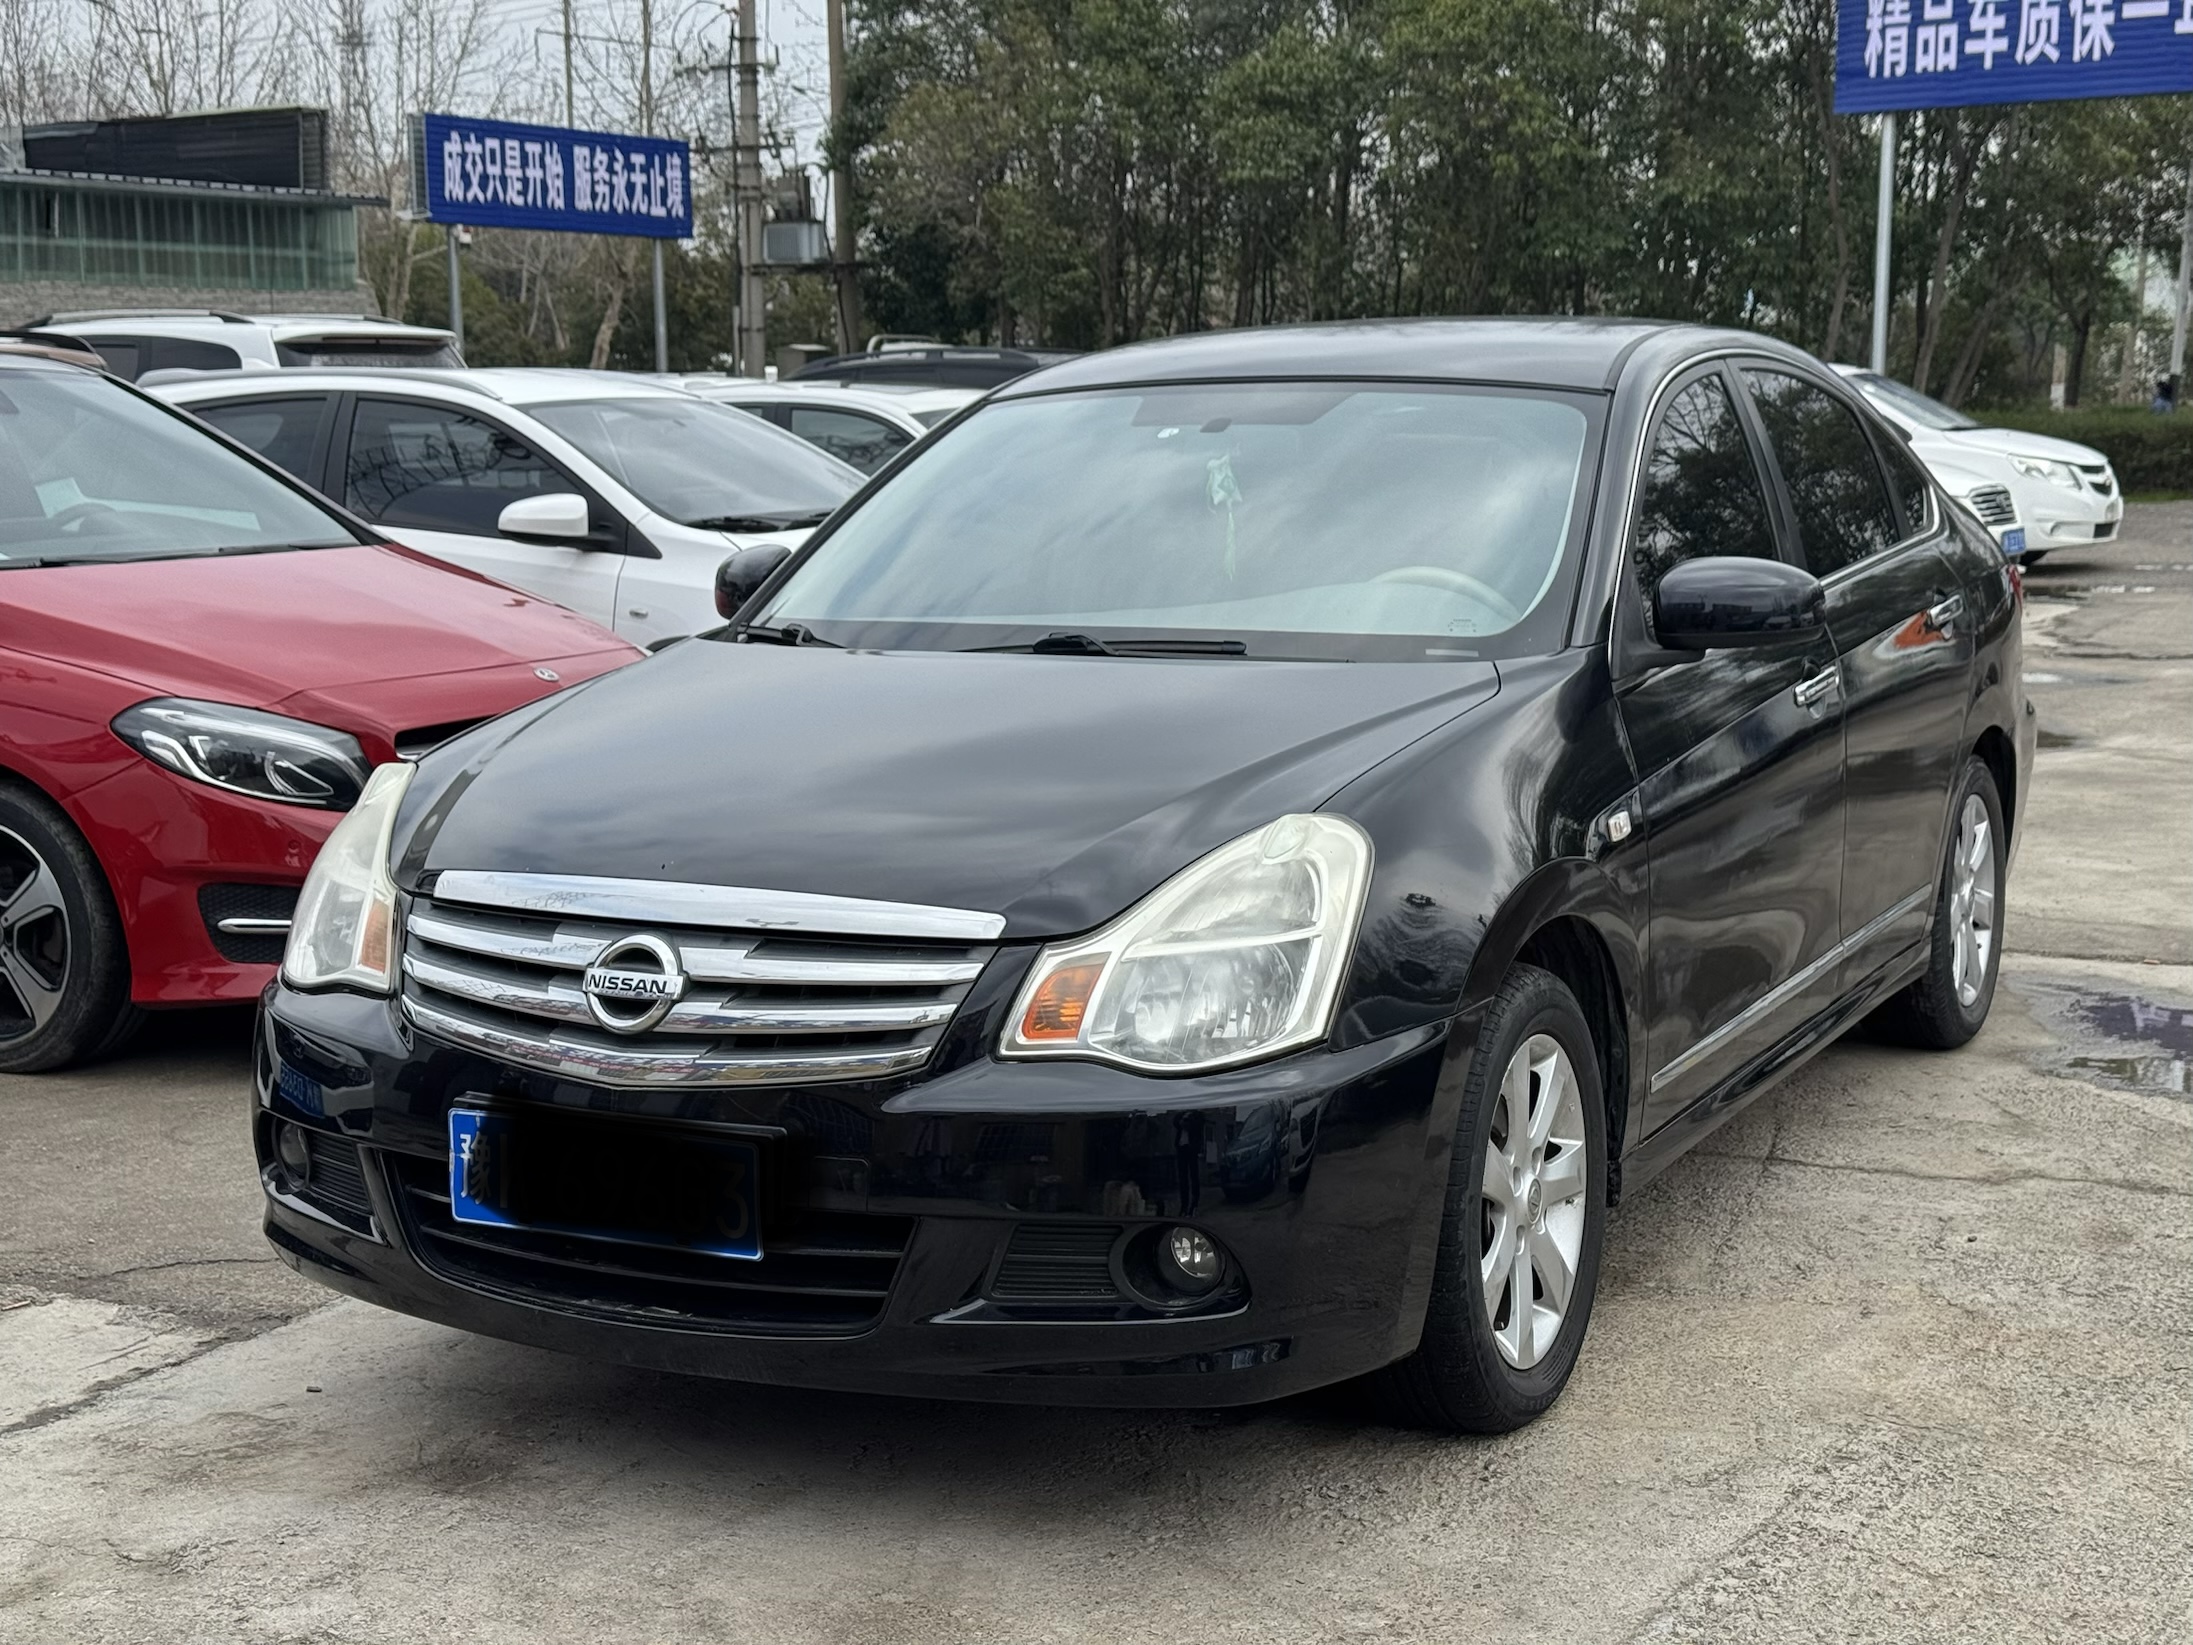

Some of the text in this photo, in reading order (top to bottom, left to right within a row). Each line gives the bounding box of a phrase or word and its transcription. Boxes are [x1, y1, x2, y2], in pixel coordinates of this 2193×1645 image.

[1863, 0, 2193, 78] 精品车质保一
[443, 130, 685, 218] 成交只是开始 服务永无止境
[588, 974, 667, 994] NISSAN
